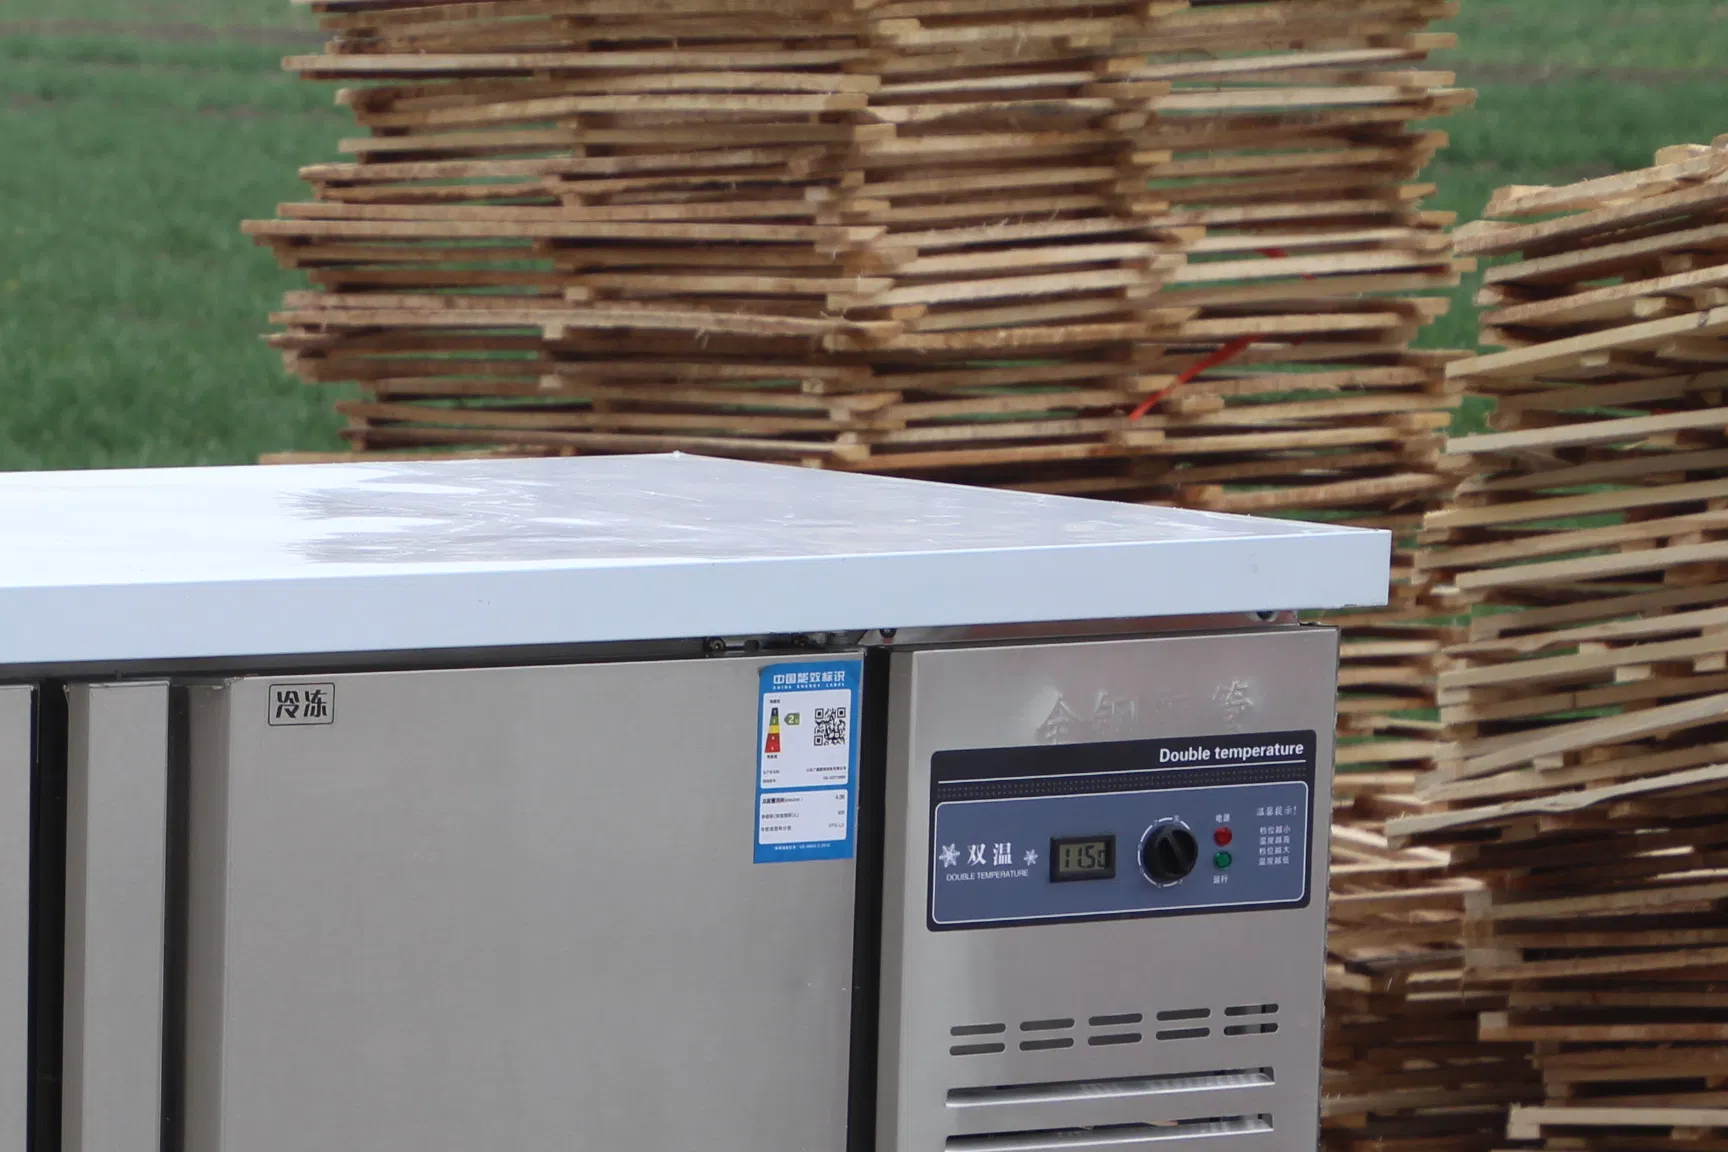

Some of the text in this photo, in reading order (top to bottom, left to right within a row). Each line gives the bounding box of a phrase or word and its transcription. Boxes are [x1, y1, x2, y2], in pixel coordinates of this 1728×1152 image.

[773, 671, 846, 685] 中国能效标识
[276, 689, 328, 719] 冷冻
[1159, 743, 1304, 763] Double temperature
[967, 842, 1012, 866] 双温
[946, 869, 1029, 881] DOUBLE TEMPERATURE
